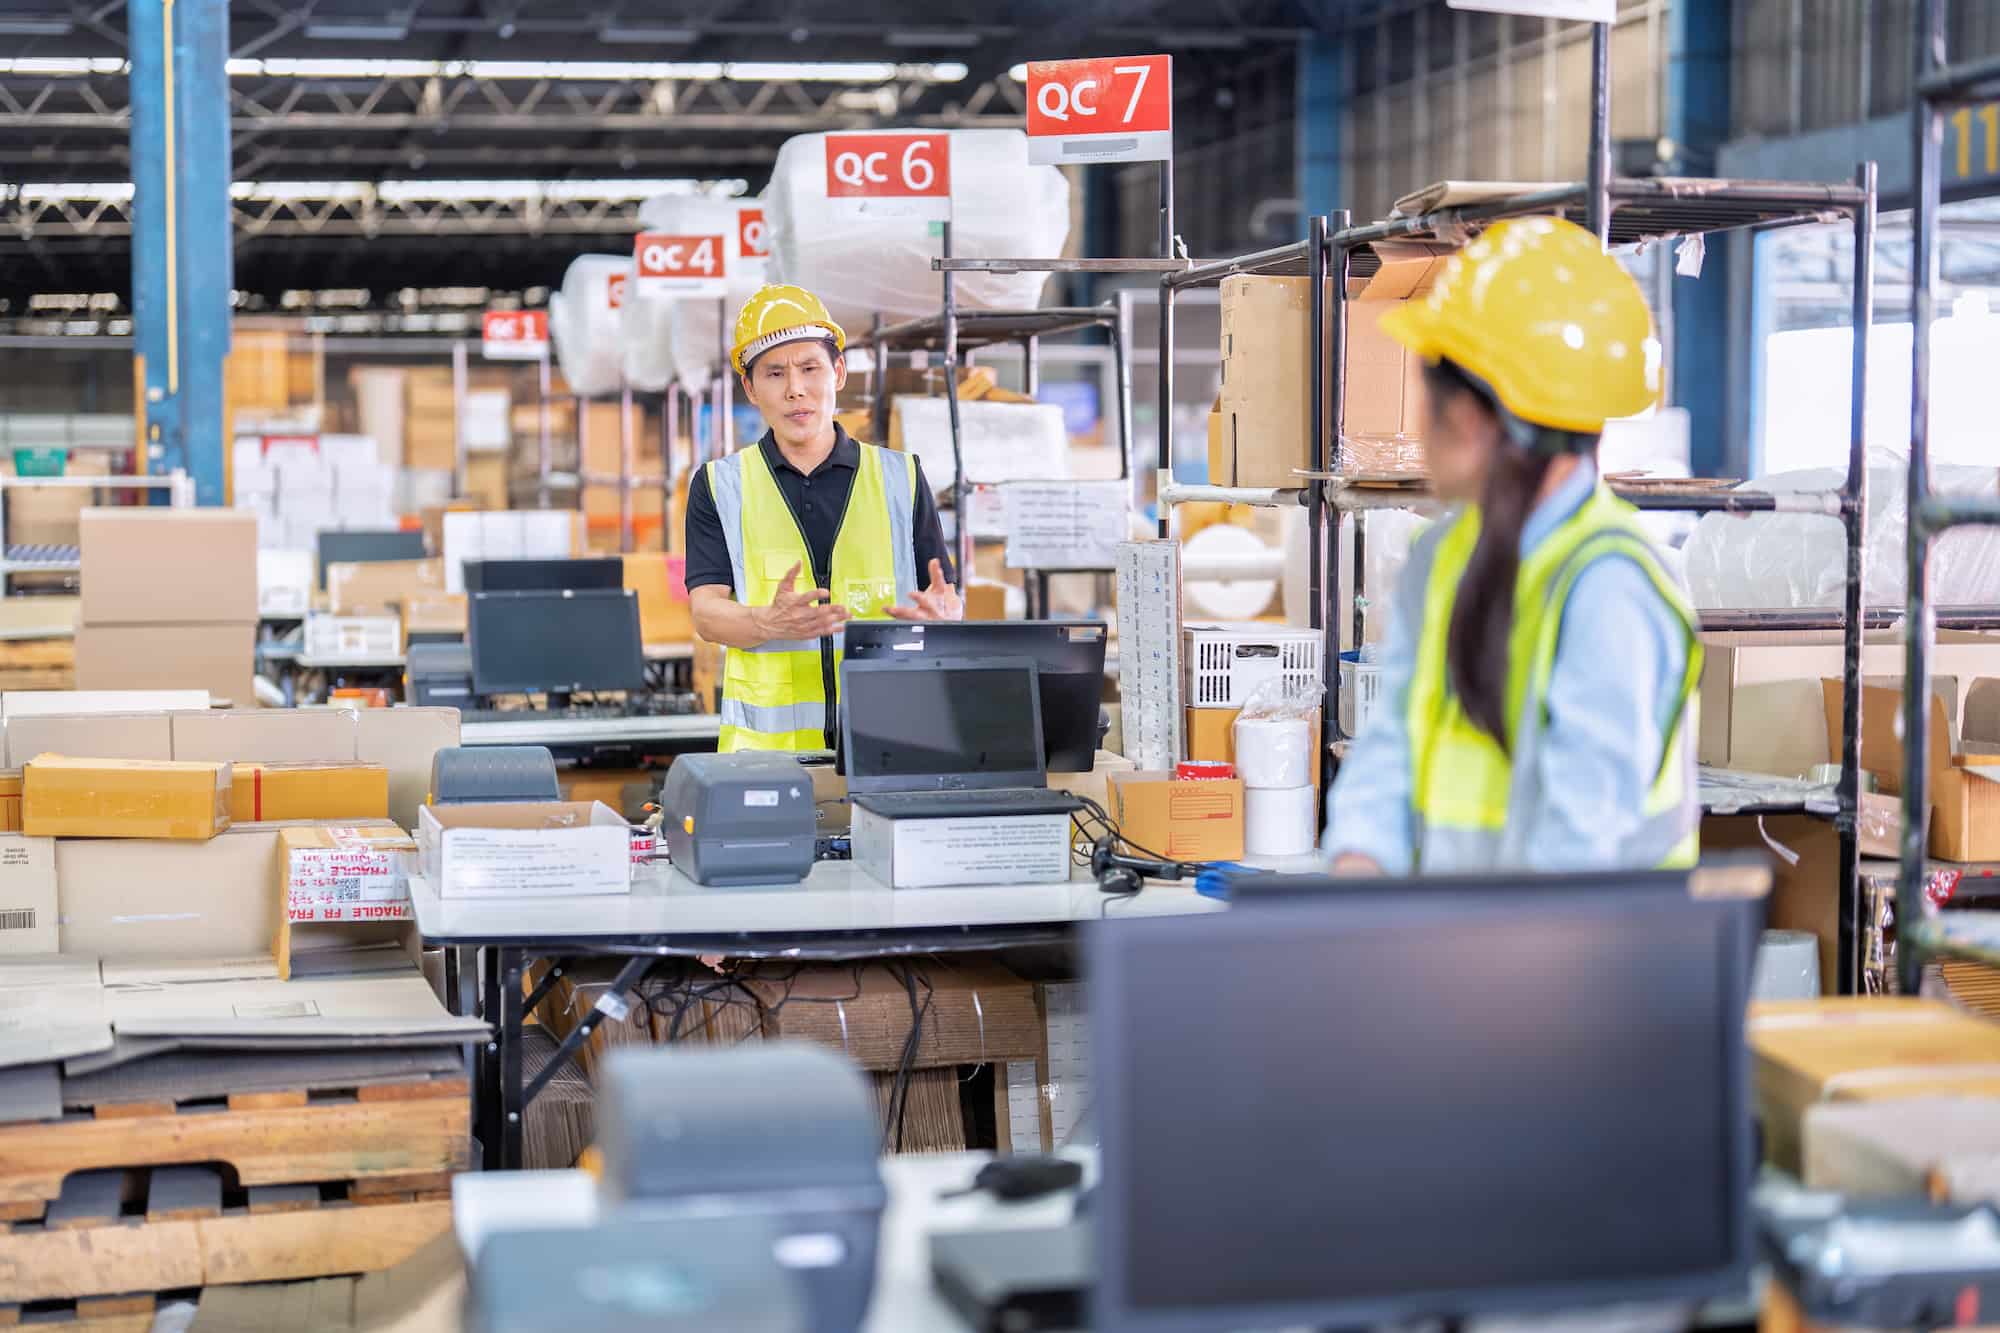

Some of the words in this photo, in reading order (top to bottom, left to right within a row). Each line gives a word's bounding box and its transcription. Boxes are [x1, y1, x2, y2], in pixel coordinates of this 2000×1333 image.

[1037, 80, 1097, 121] QC
[1114, 65, 1150, 123] 7
[834, 151, 888, 187] QC
[902, 140, 934, 190] 6
[642, 244, 684, 271] QC
[689, 239, 716, 274] 4
